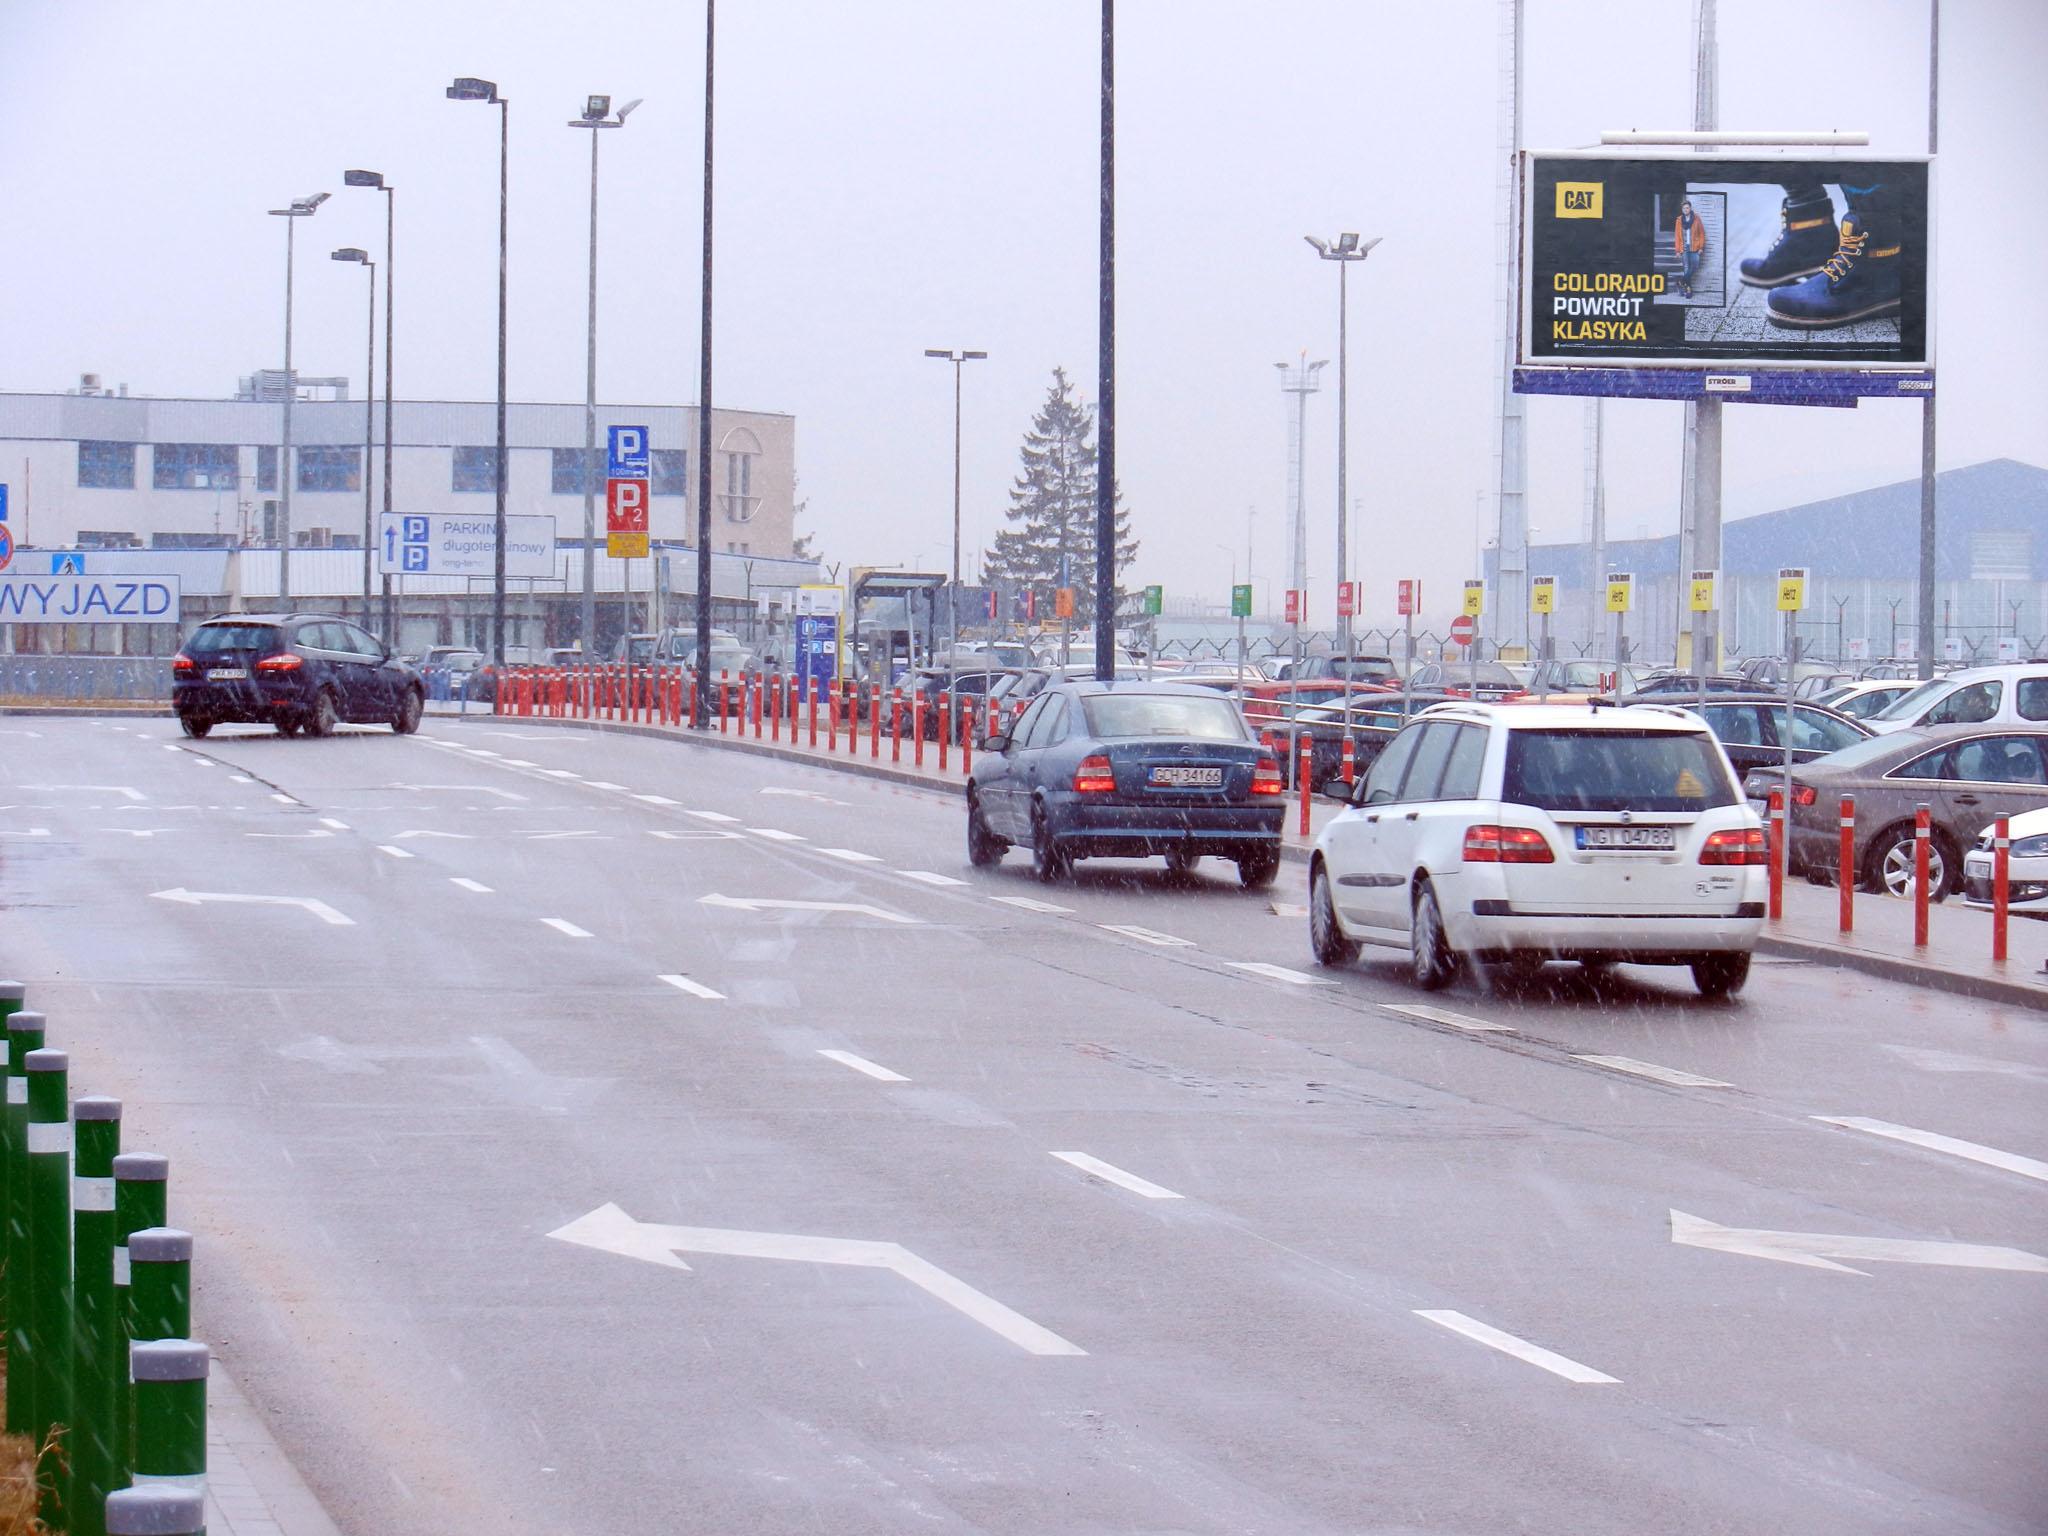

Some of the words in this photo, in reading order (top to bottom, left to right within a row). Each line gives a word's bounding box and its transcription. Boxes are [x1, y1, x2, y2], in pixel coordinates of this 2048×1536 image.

[1564, 190, 1595, 210] CAT
[1553, 272, 1665, 293] COLORADO
[1552, 293, 1644, 316] POWRÓT
[1552, 320, 1647, 341] KLASYKA
[617, 429, 641, 463] P
[616, 483, 640, 516] P
[633, 508, 643, 522] 2
[409, 519, 425, 540] P
[443, 522, 508, 535] PARKIN
[408, 548, 424, 569] P
[0, 583, 171, 615] WYJAZD
[1155, 768, 1179, 781] GCH
[1183, 768, 1220, 782] 34166
[1621, 829, 1671, 844] 04789
[1697, 883, 1711, 893] PL
